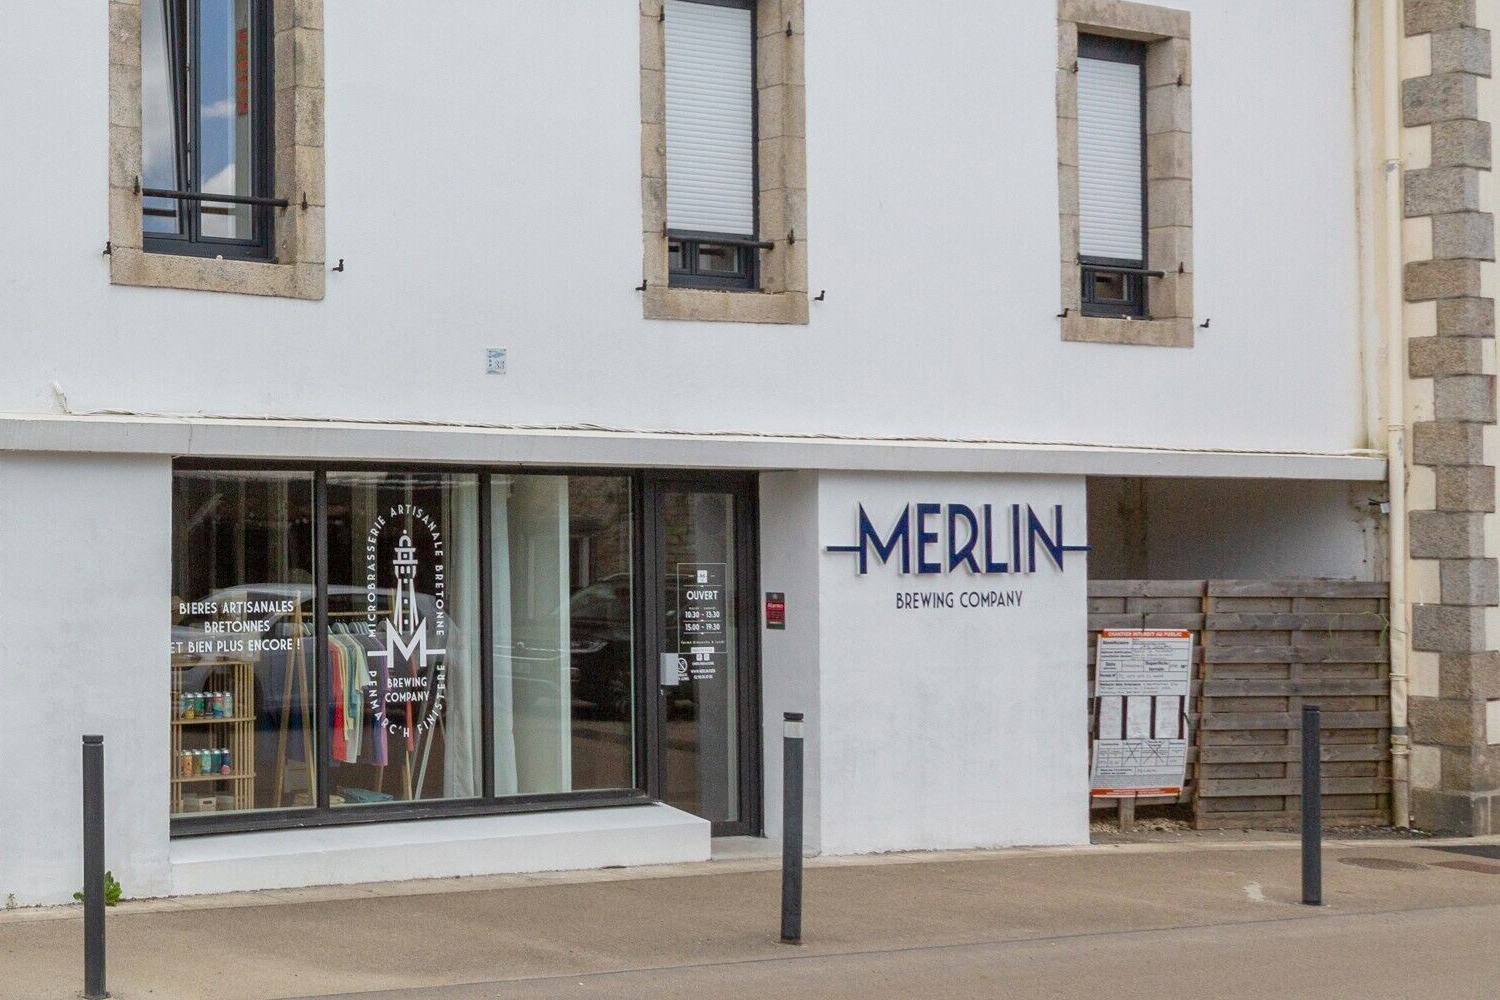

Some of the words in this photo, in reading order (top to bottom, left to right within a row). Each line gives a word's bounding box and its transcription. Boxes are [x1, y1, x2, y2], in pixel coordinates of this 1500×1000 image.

[858, 501, 1064, 575] MERLIN
[367, 515, 386, 638] MICROBRASSERIE
[390, 504, 444, 557] ARTISANALE
[435, 565, 444, 636] BRETONNE
[686, 590, 718, 600] OUVERT
[896, 592, 954, 609] BREWING
[960, 590, 1023, 608] COMPANY
[179, 602, 218, 614] BIERES
[222, 600, 294, 614] ARTISANALES
[204, 620, 270, 633] BRETONNES
[188, 641, 212, 652] BIEN
[217, 640, 244, 652] PLUS
[248, 638, 293, 651] ENCORE
[296, 638, 300, 650] !
[386, 617, 427, 668] M
[387, 676, 427, 688] BREWING
[384, 692, 430, 702] COMPANY
[417, 665, 446, 734] FINISTERE
